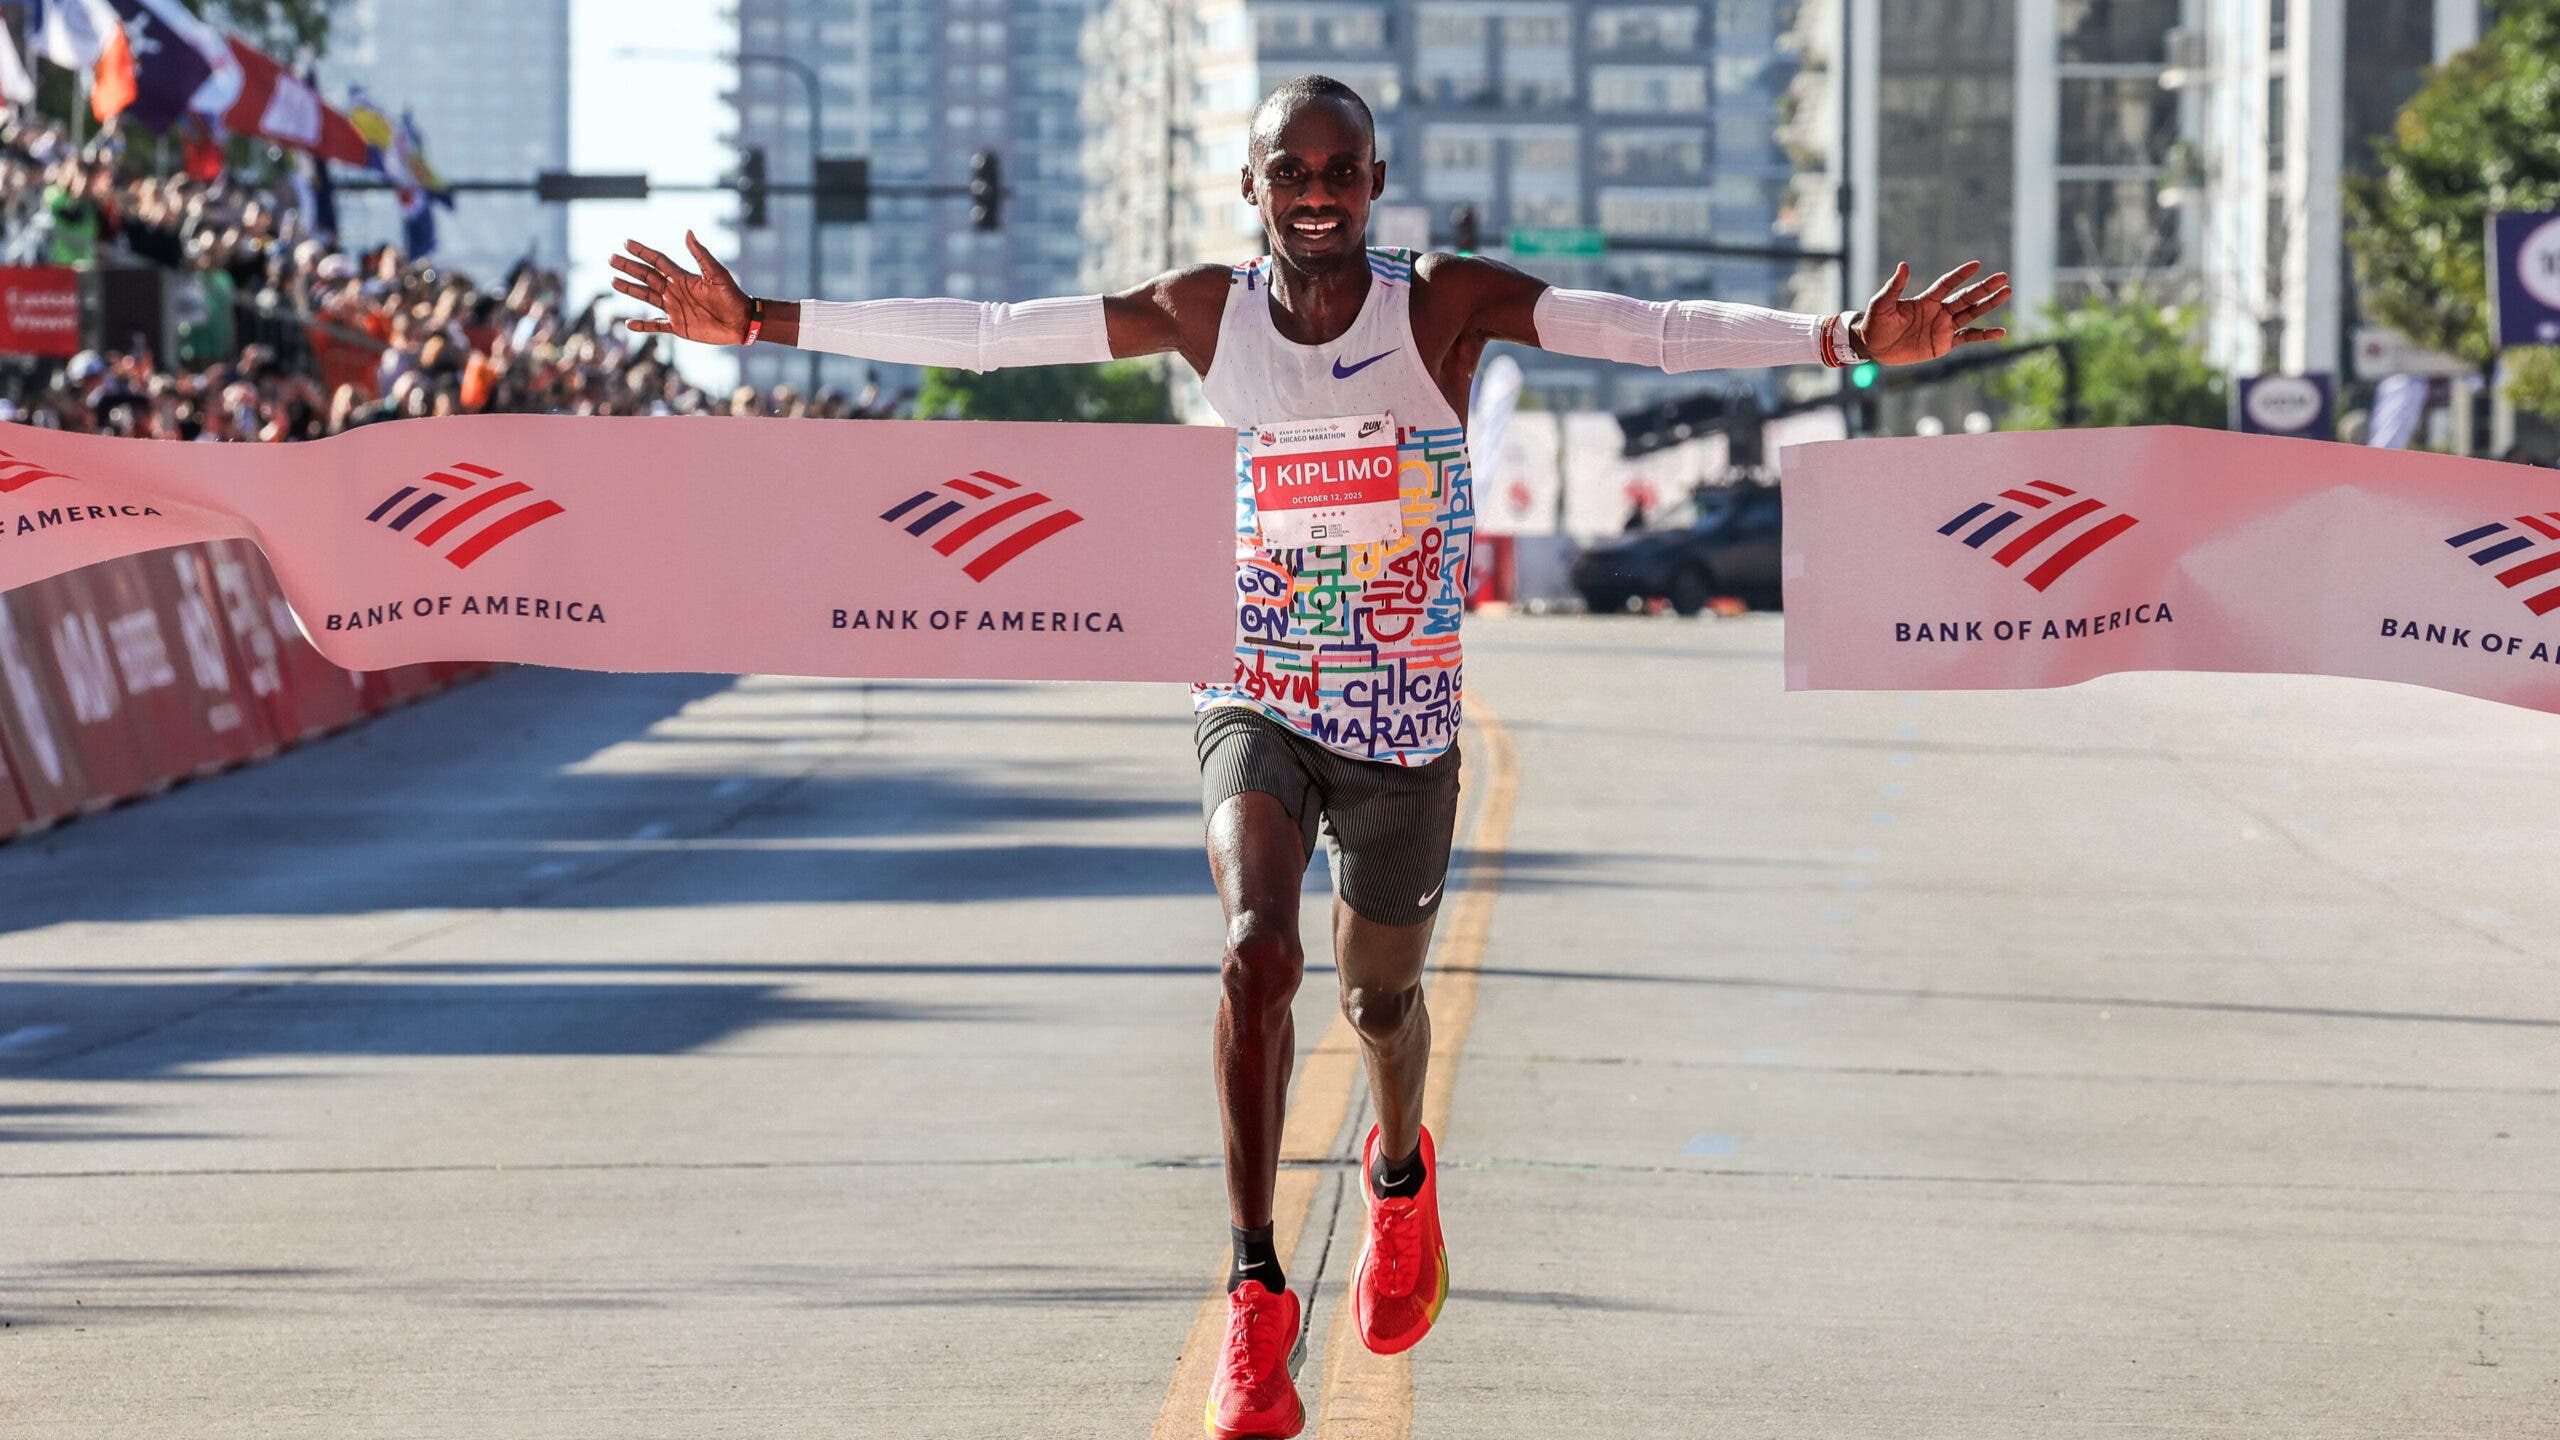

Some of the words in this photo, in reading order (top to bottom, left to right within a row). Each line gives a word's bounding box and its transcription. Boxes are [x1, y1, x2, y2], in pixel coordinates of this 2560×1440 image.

[1280, 436, 1307, 444] CHICAGO
[1309, 432, 1346, 441] MARATHON
[1362, 420, 1382, 431] RUN
[1257, 466, 1267, 493] J
[1277, 456, 1393, 487] KIPLIMO
[1292, 495, 1328, 504] OCTOBER
[1331, 494, 1341, 502] 12,
[1344, 492, 1362, 500] 2025
[17, 505, 163, 537] AMERICA
[326, 601, 403, 631] BANK
[413, 596, 453, 617] OF
[462, 596, 606, 623] AMERICA
[832, 609, 919, 630] BANK
[929, 610, 969, 631] OF
[977, 611, 1125, 633] AMERICA
[1895, 621, 1984, 642] BANK
[1993, 620, 2033, 641] OF
[2041, 602, 2174, 640] AMERICA
[2381, 618, 2472, 648] BANK
[2481, 633, 2524, 656] OF
[1343, 657, 1462, 708] CHICAG
[1311, 700, 1462, 758] MARATHO
